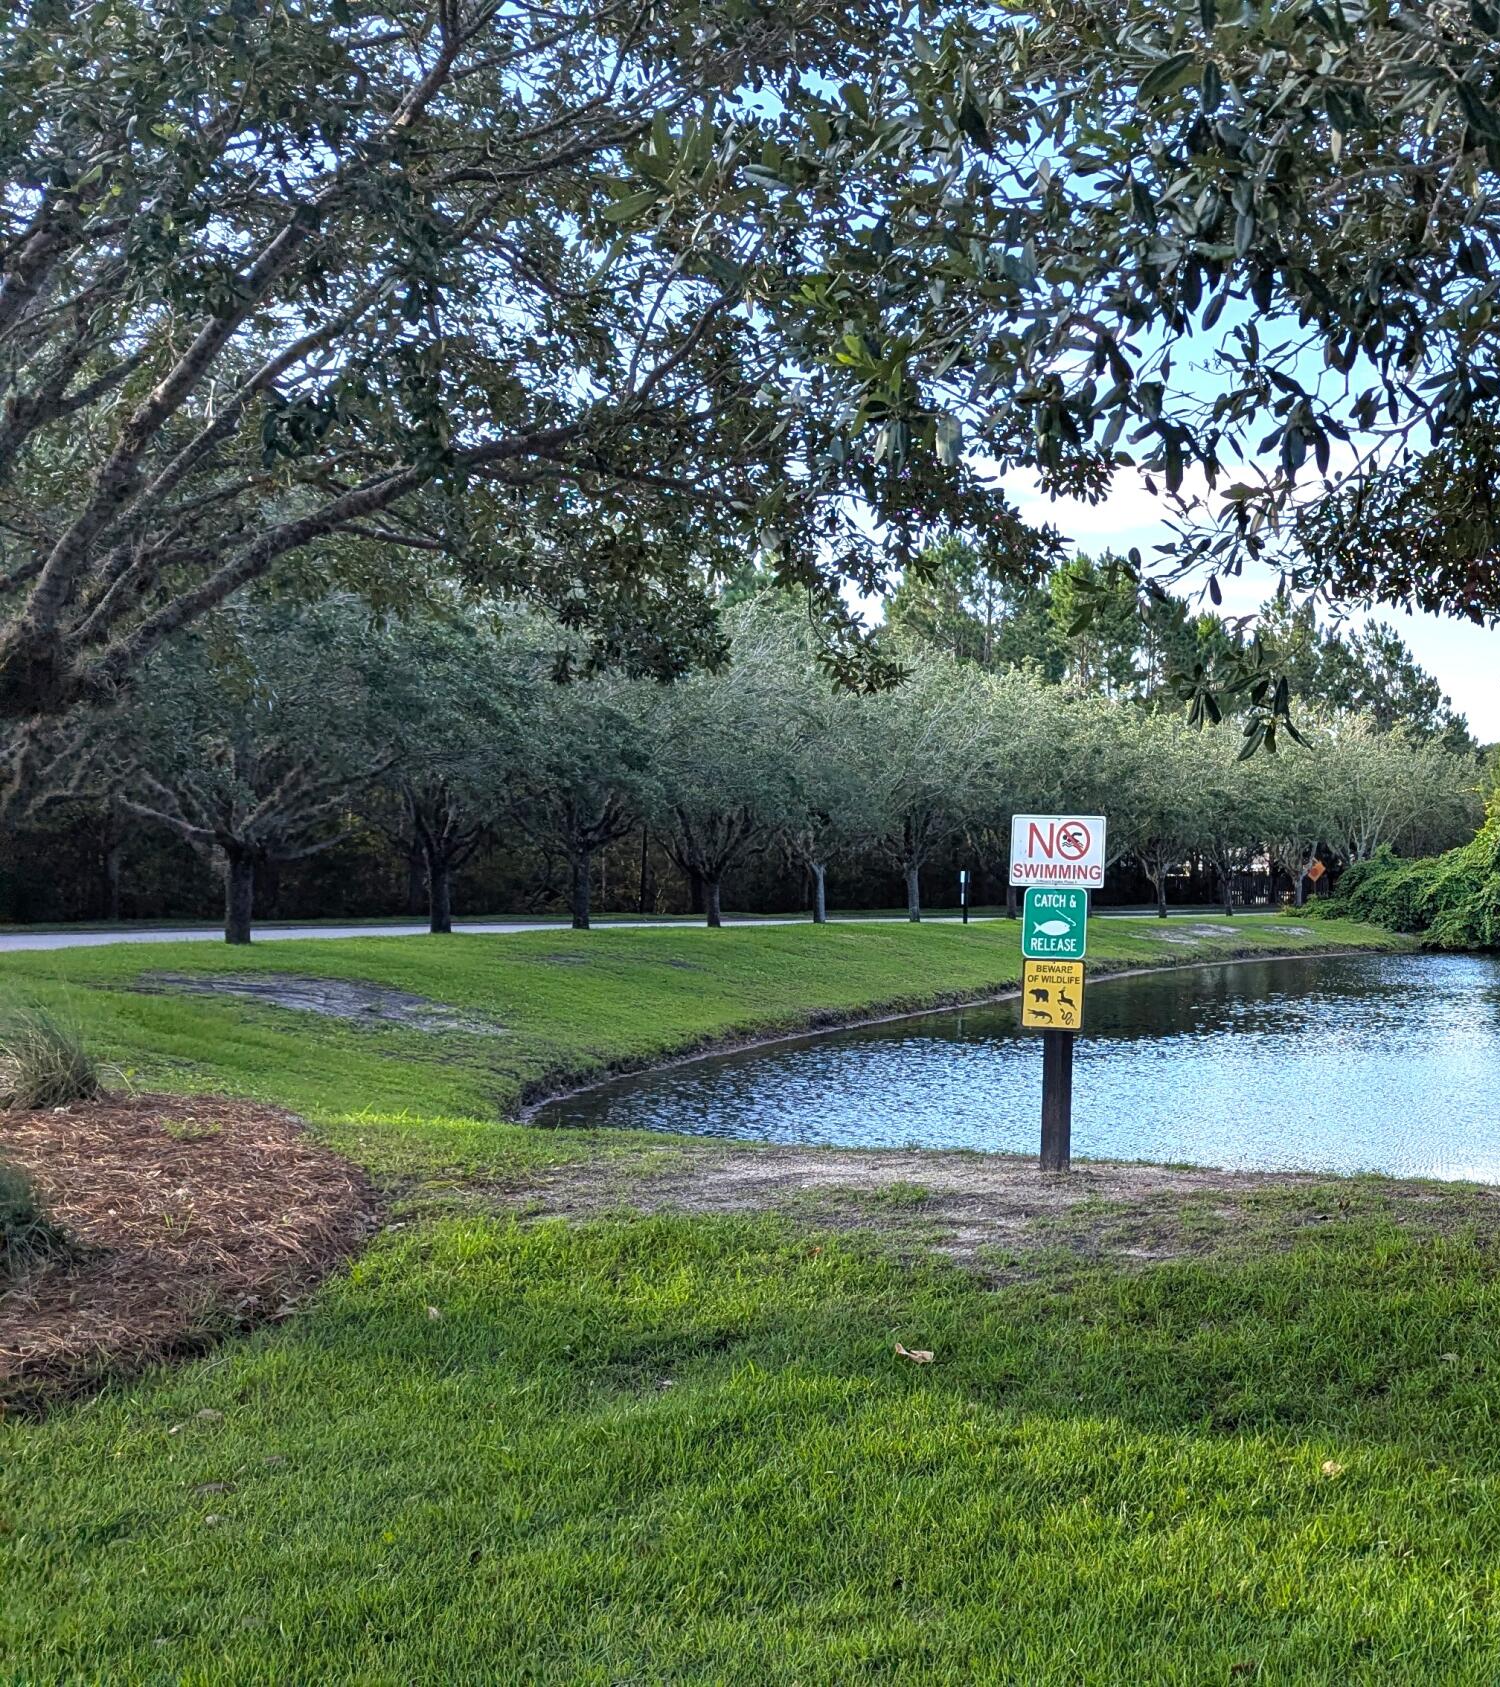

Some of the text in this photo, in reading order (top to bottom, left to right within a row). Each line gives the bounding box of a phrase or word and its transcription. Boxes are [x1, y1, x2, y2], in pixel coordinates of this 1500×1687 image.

[1028, 821, 1090, 860] NO
[1013, 863, 1101, 880] SWIMMING
[1034, 894, 1077, 908] CATCH &
[1030, 938, 1077, 952] RELEASE
[1036, 964, 1073, 974] BEWARE
[1027, 975, 1080, 985] OF WILDLIFE
